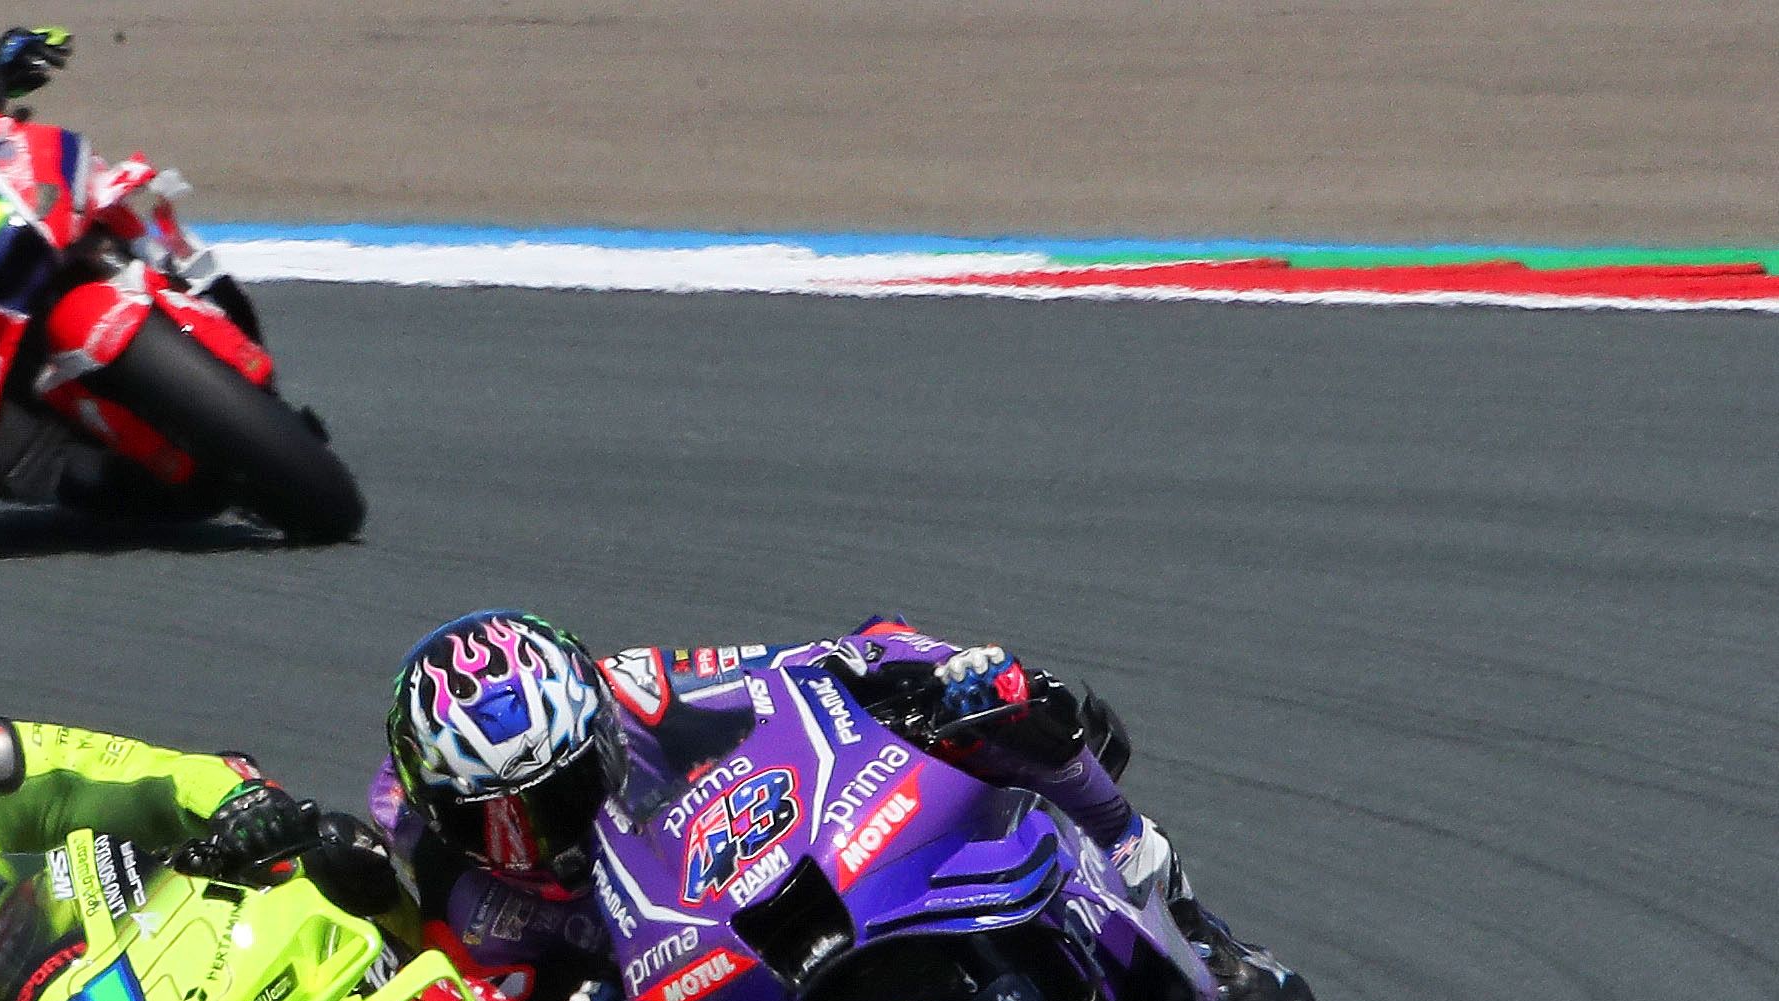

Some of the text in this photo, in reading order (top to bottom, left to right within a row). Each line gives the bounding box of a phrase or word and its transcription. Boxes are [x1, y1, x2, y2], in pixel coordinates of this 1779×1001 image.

[820, 677, 861, 745] PRAMAC
[664, 756, 753, 838] prima
[824, 743, 910, 828] prima
[683, 767, 800, 905] 43
[839, 792, 918, 873] MOTUL
[94, 834, 127, 920] LINO SONEGO
[120, 840, 146, 907] CUPRA
[592, 859, 639, 939] PRAMAC
[625, 926, 701, 996] prima
